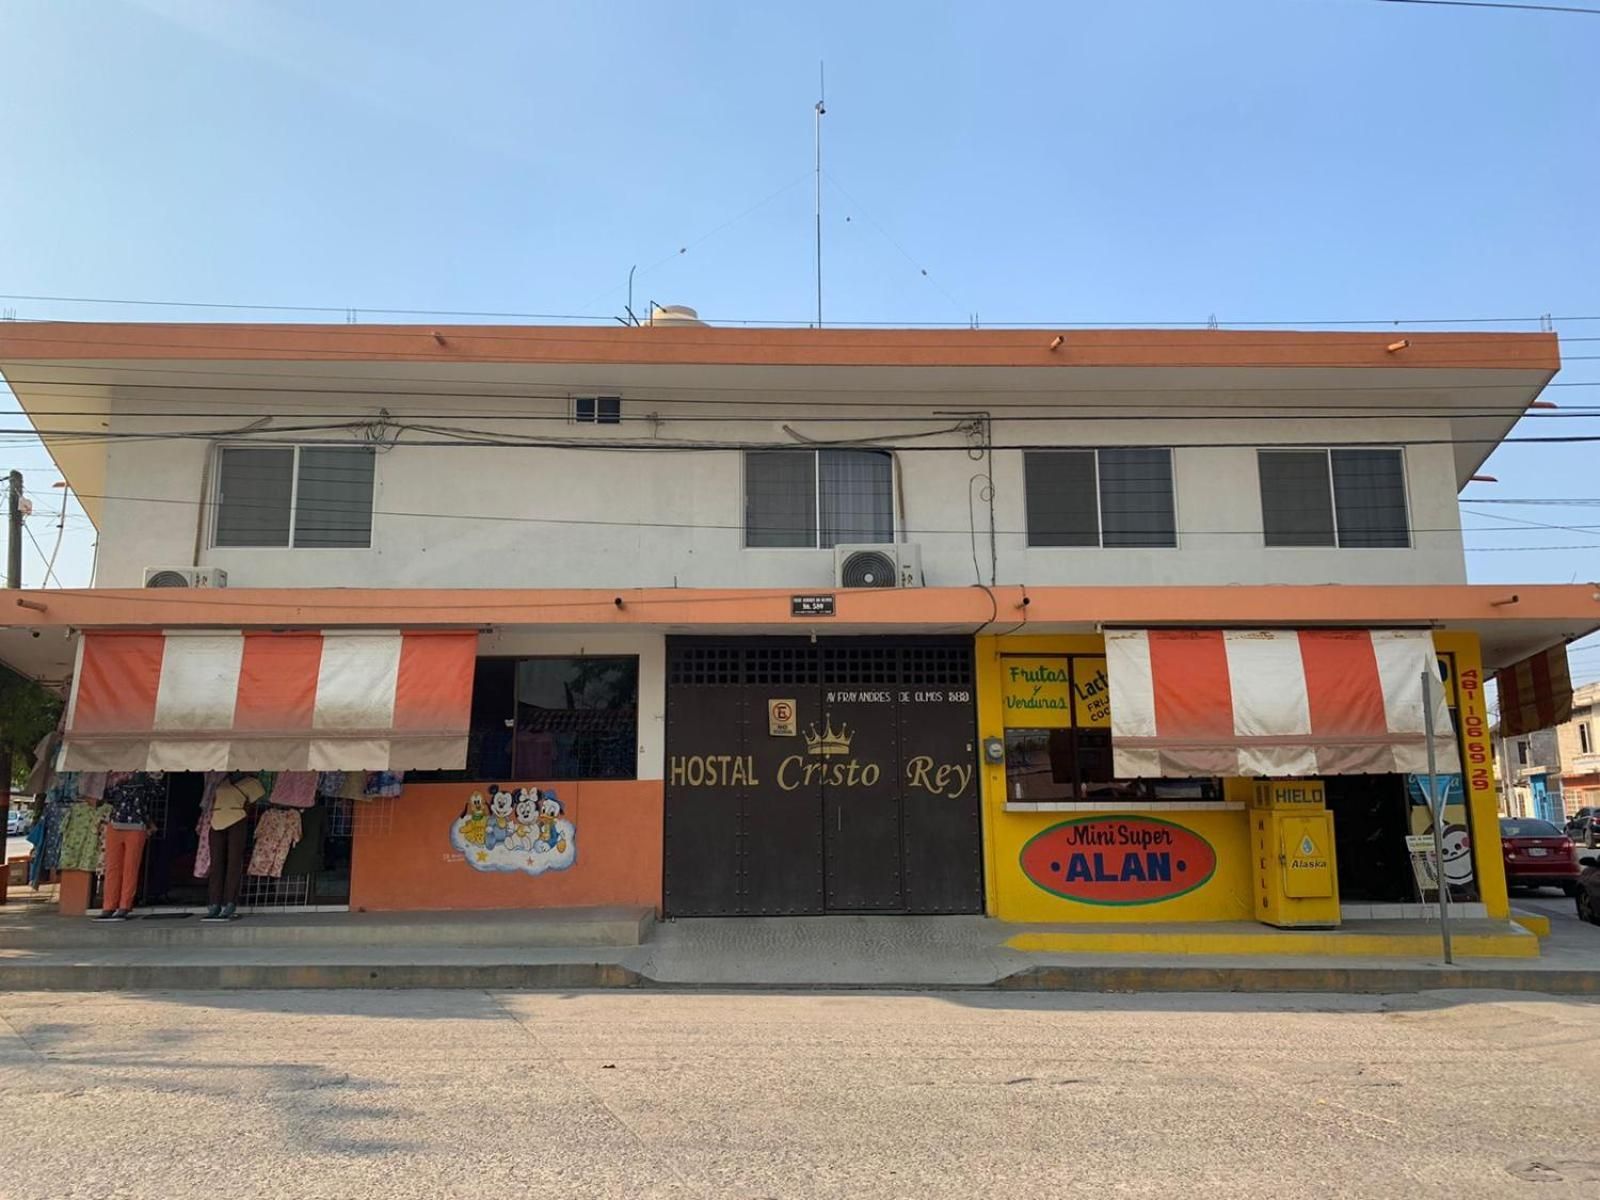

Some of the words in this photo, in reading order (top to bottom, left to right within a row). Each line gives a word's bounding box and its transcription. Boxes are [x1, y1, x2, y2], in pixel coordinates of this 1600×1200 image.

[1009, 666, 1068, 682] Frutas
[1074, 670, 1108, 700] Lact
[1461, 669, 1478, 700] 481
[858, 691, 891, 703] ANDRES
[914, 691, 943, 703] OLMOS
[1006, 695, 1067, 710] Verduras
[1465, 706, 1482, 737] 106
[1468, 742, 1486, 764] 69
[670, 755, 759, 787] HOSTAL
[776, 755, 880, 791] Cristo
[906, 755, 972, 799] Rey
[1275, 788, 1323, 803] HIELO
[1066, 824, 1116, 846] Mini
[1117, 824, 1173, 851] Super
[1066, 852, 1171, 882] ALAN
[1291, 859, 1327, 869] Alaska
